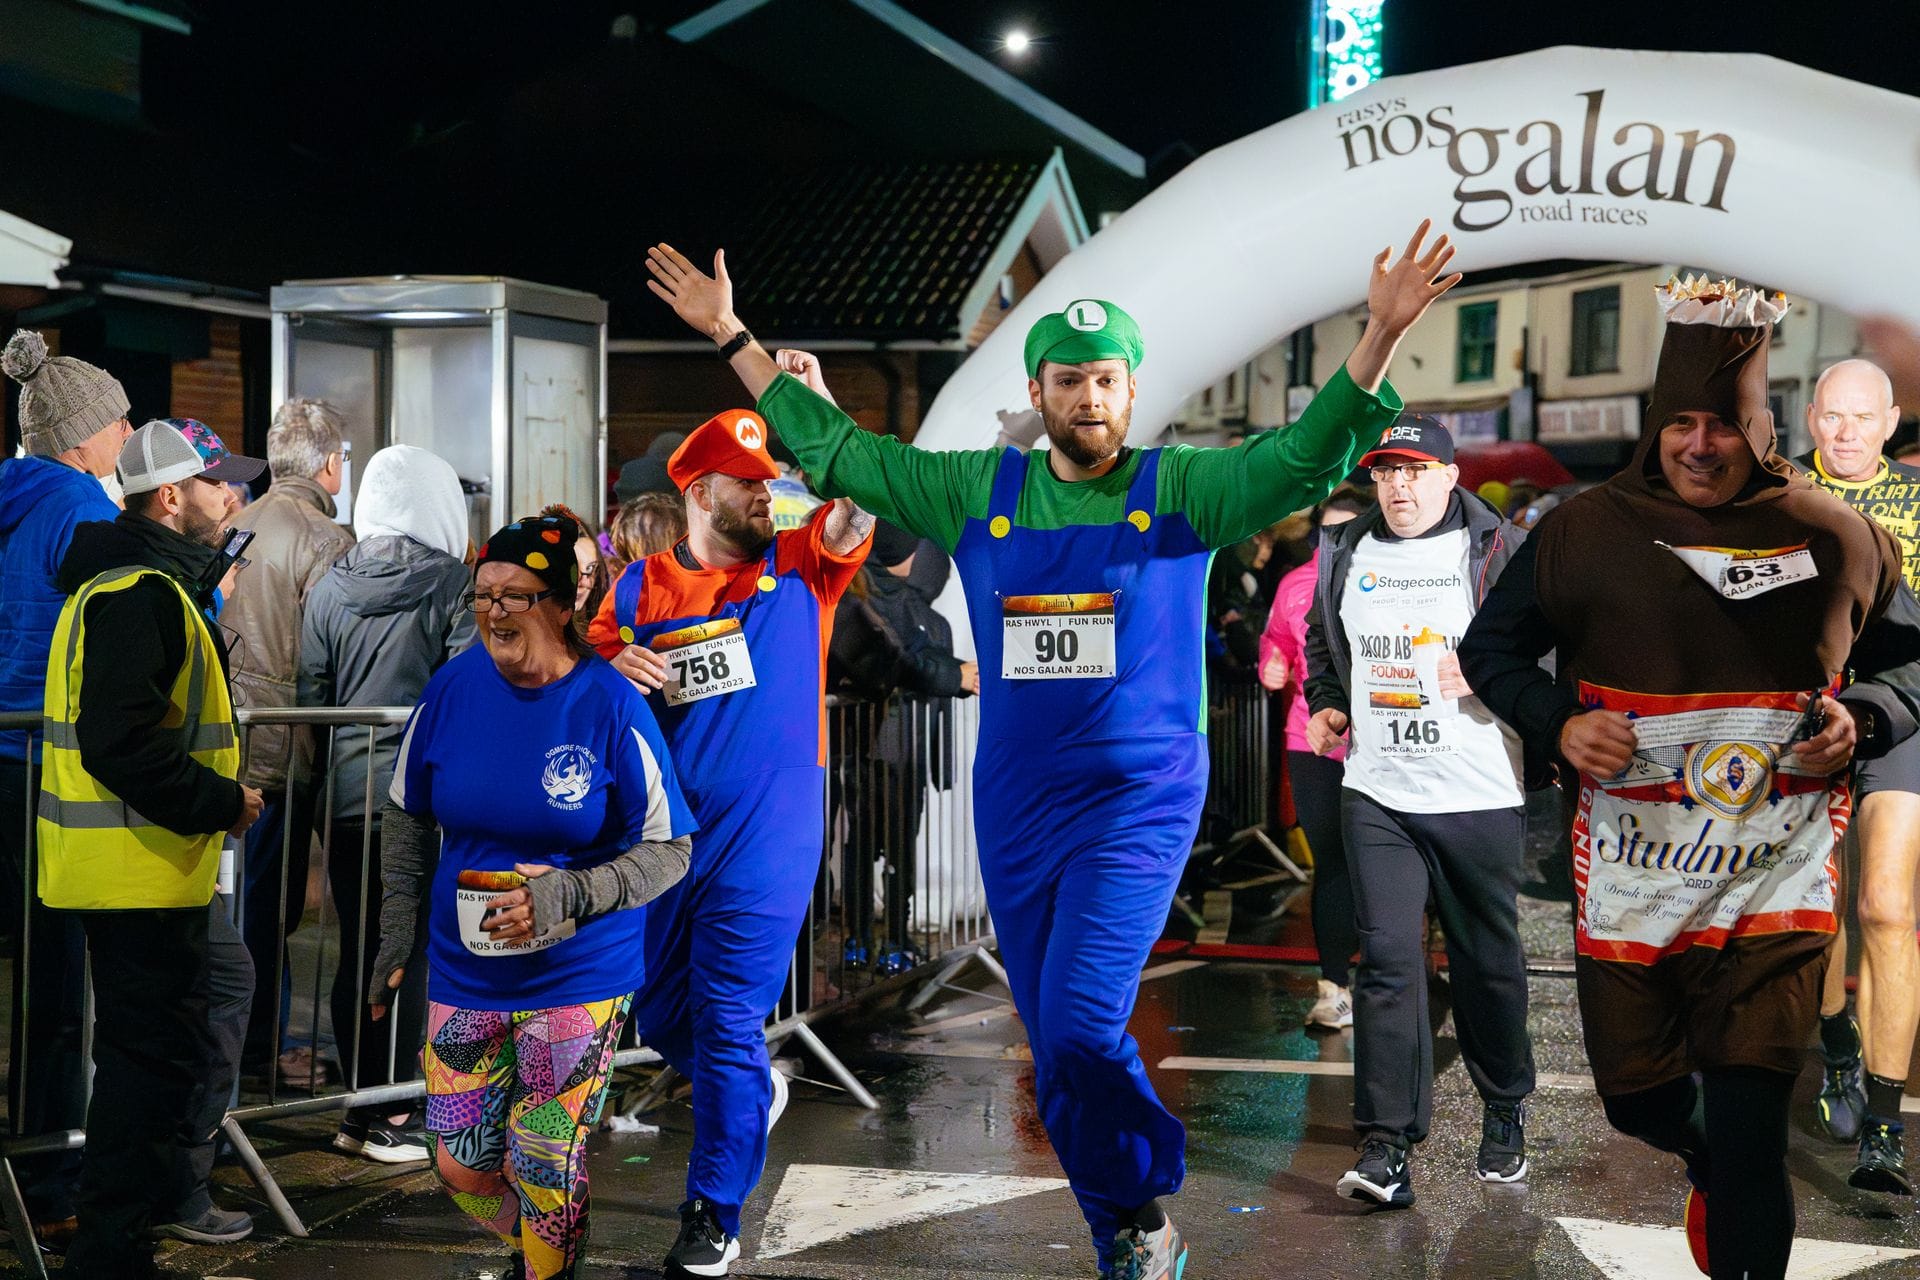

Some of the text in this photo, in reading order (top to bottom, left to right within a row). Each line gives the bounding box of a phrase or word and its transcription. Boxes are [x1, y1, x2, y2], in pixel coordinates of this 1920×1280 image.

[1336, 97, 1408, 129] rasys
[1337, 88, 1736, 232] nos galan
[1519, 198, 1649, 226] road races
[1076, 307, 1099, 326] L
[740, 423, 760, 441] M
[1391, 426, 1422, 438] OFC
[1378, 574, 1461, 590] Stagecoach
[1722, 563, 1783, 585] 63
[1372, 597, 1396, 605] PROUD
[1005, 619, 1023, 628] RAS
[1025, 618, 1052, 627] HWYL
[1068, 617, 1089, 626] FUN
[1092, 616, 1114, 625] RUN
[669, 648, 693, 660] HWYL
[705, 641, 723, 650] FUN
[726, 635, 745, 645] RUN
[1035, 629, 1079, 663] 90
[671, 651, 731, 689] 758
[1014, 665, 1103, 675] NOS GALAN 2023
[670, 677, 744, 702] NOS GALAN 2023
[1388, 719, 1441, 745] 146
[545, 744, 598, 765] OGMORE PHOENIX
[1430, 745, 1452, 753] 2023
[546, 797, 584, 811] RUNNERS
[458, 892, 500, 902] RAS HW
[1604, 881, 1640, 899] Drink
[1643, 889, 1676, 902] when
[469, 940, 491, 950] NOS
